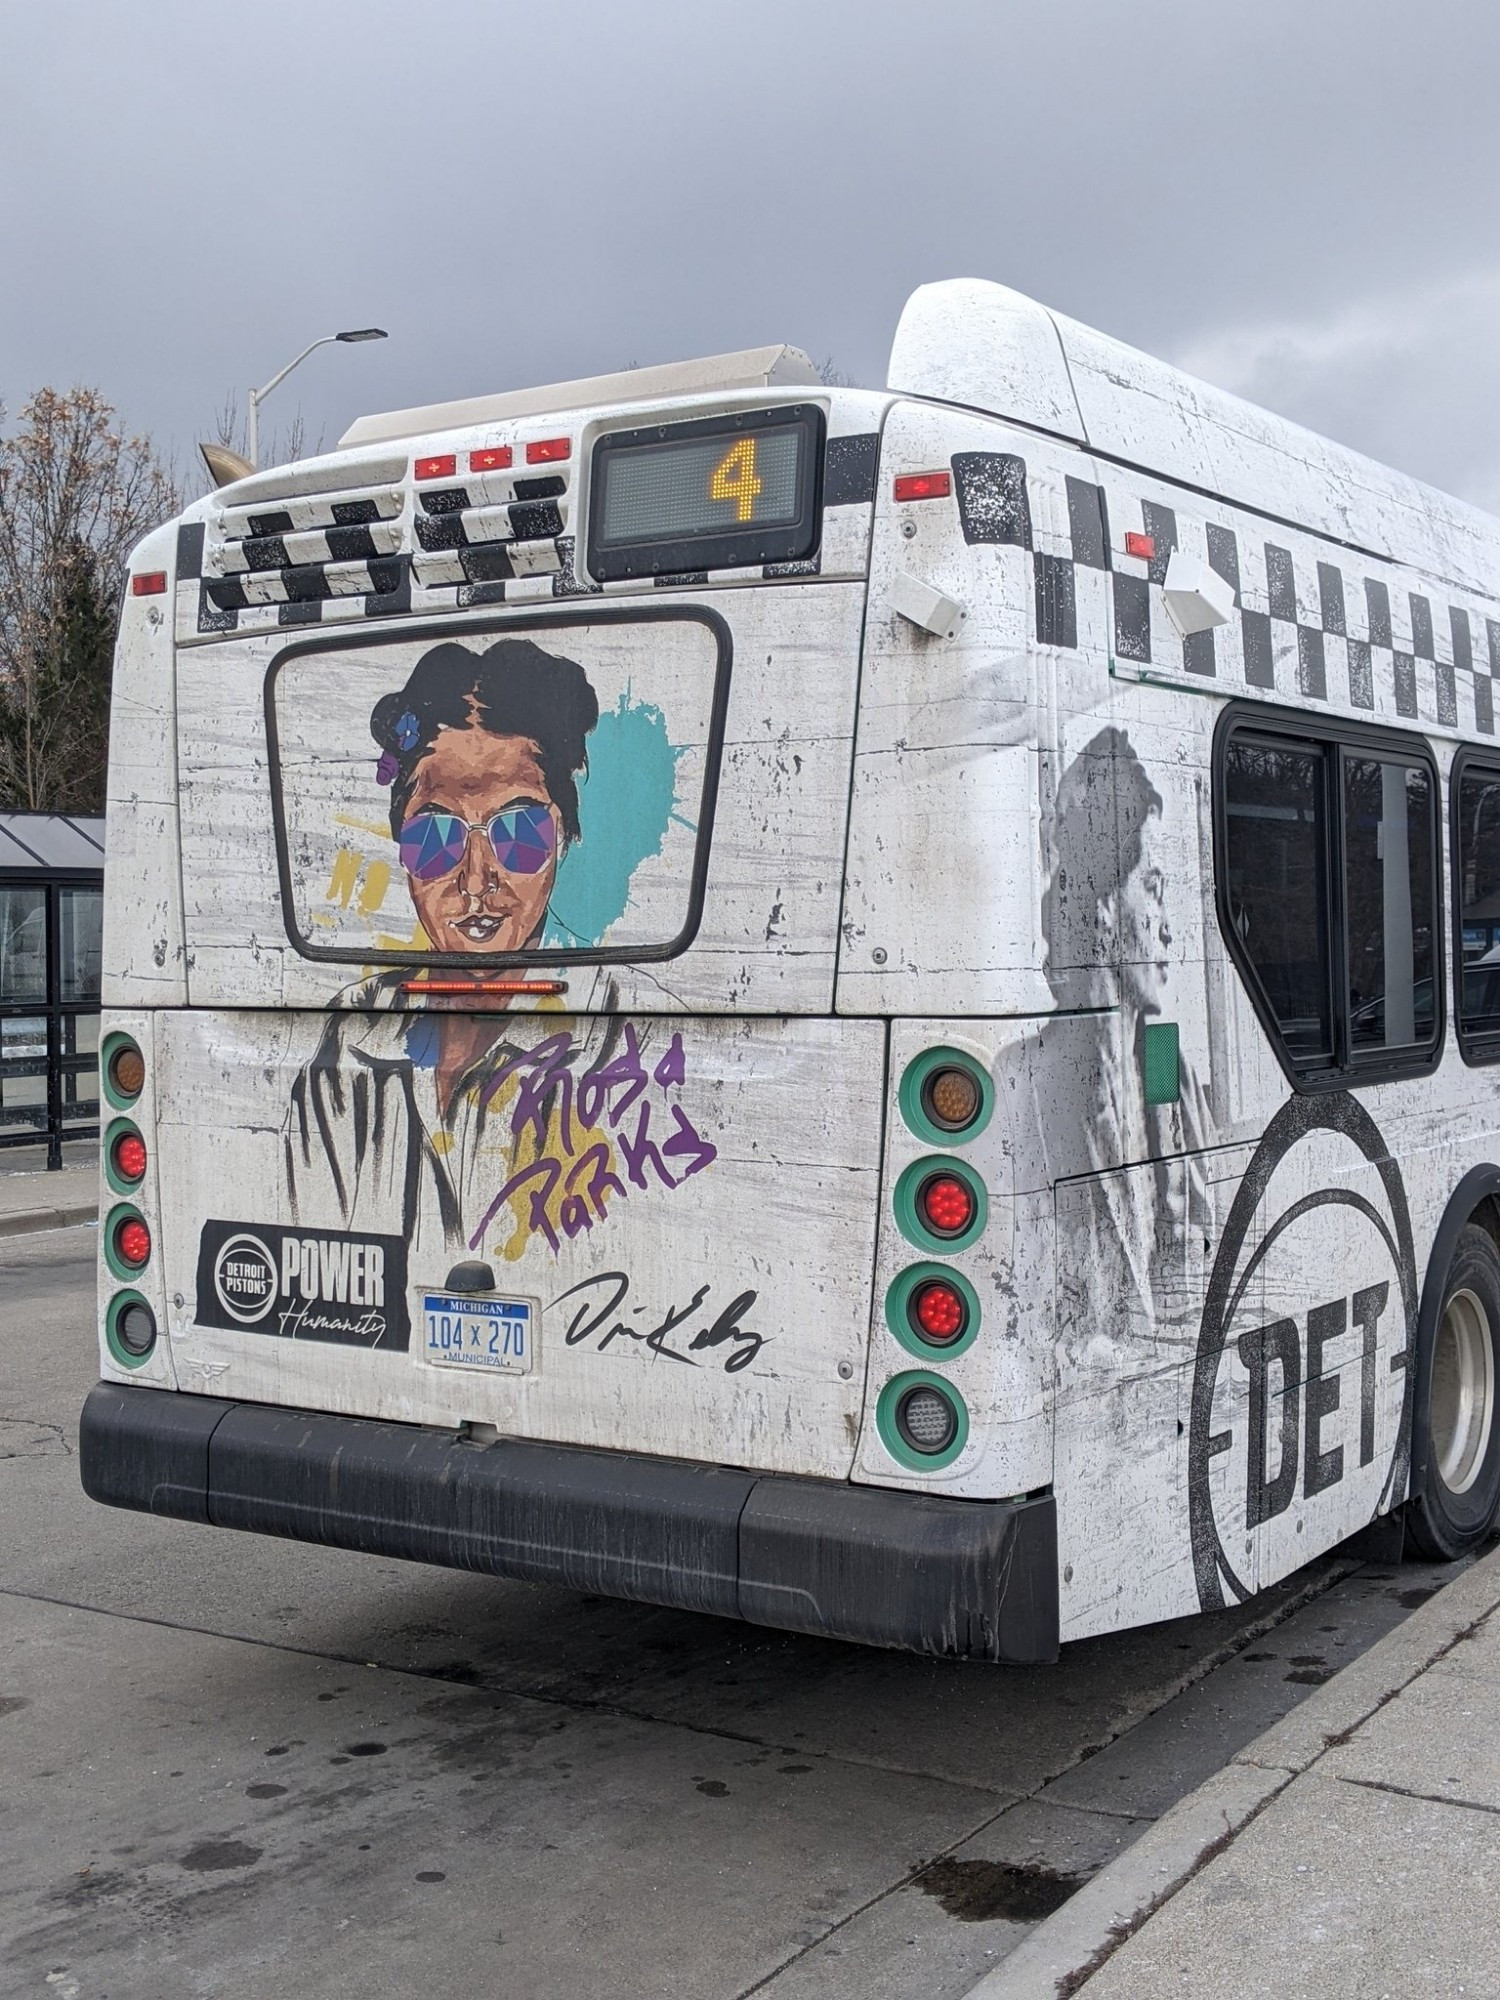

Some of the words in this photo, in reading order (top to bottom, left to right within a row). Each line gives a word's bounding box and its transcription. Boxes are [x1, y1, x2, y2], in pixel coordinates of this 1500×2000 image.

[711, 437, 762, 522] 4
[225, 1276, 267, 1296] PISTONS
[226, 1261, 267, 1280] DETROIT
[281, 1236, 385, 1308] POWER
[278, 1298, 387, 1350] Humanity
[449, 1300, 504, 1316] MICHIGAN
[428, 1314, 463, 1351] 104
[488, 1319, 524, 1357] 270
[448, 1351, 508, 1367] MUNICIPAL
[1237, 1279, 1390, 1531] DET
